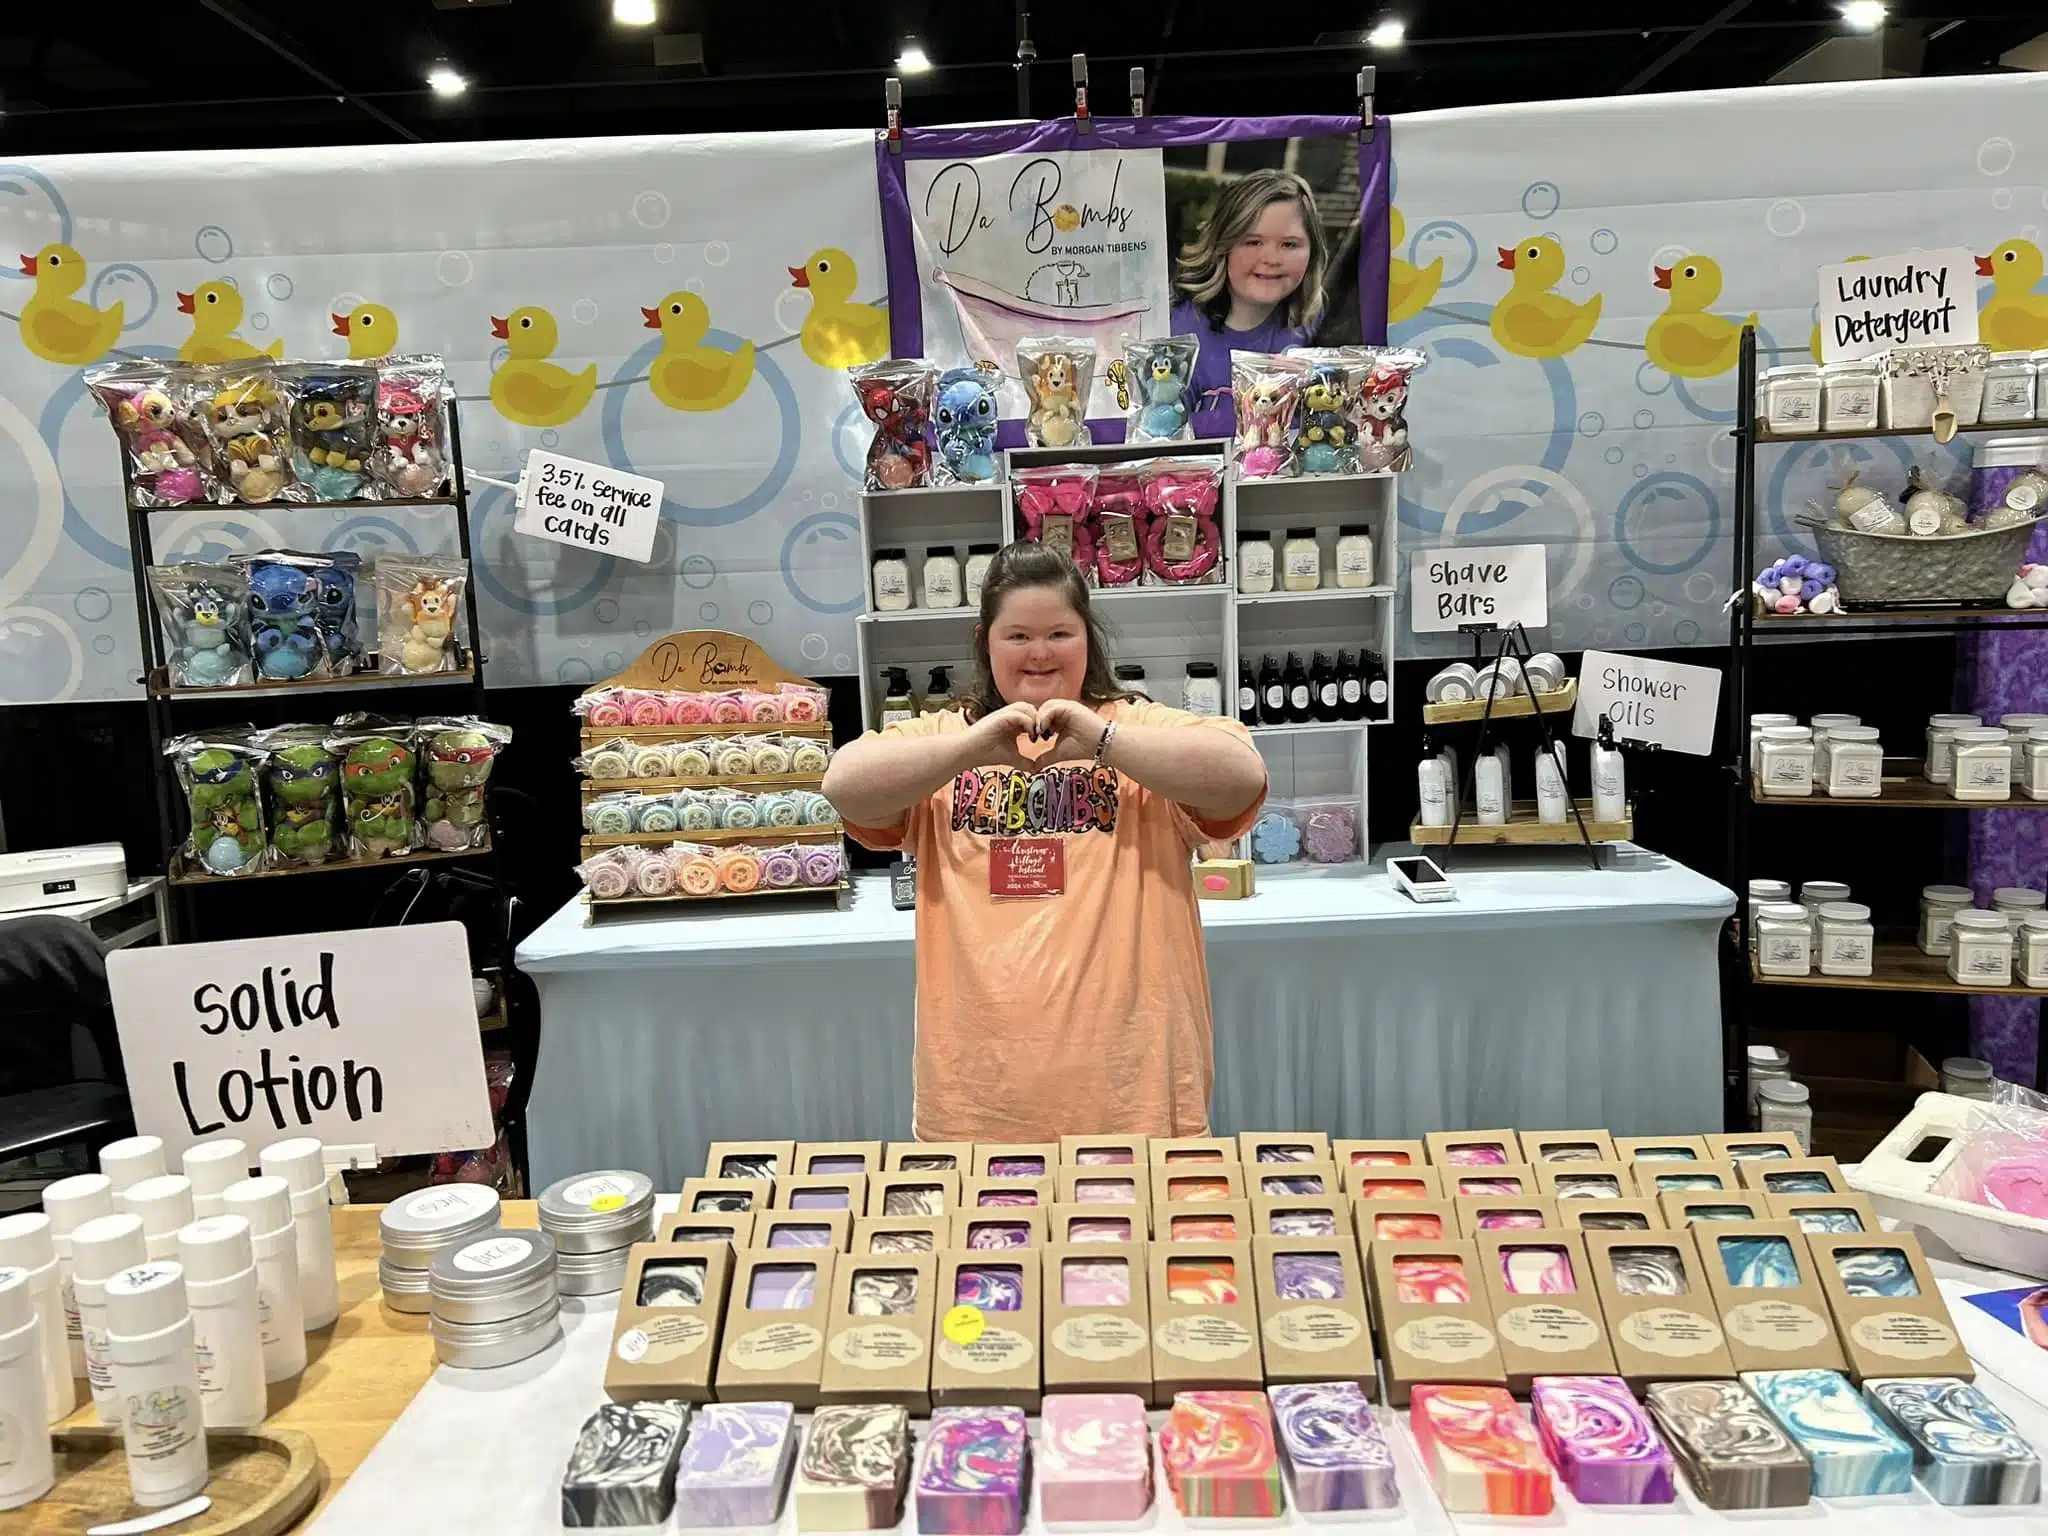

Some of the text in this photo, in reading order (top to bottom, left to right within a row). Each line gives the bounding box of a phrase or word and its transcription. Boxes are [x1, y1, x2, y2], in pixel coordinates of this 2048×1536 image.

[925, 158, 1134, 258] Da Bombs
[1051, 241, 1147, 256] BY MORGAN TIBBENS
[1837, 265, 1948, 303] Laundry
[1834, 297, 1956, 348] Detergent
[542, 463, 586, 490] 3.5%
[535, 486, 627, 527] fee on all
[1429, 561, 1508, 586] Shave
[1437, 593, 1496, 619] Bars
[1601, 668, 1687, 701] Shower
[1608, 700, 1656, 727] Oils
[173, 1048, 383, 1136] Lotion
